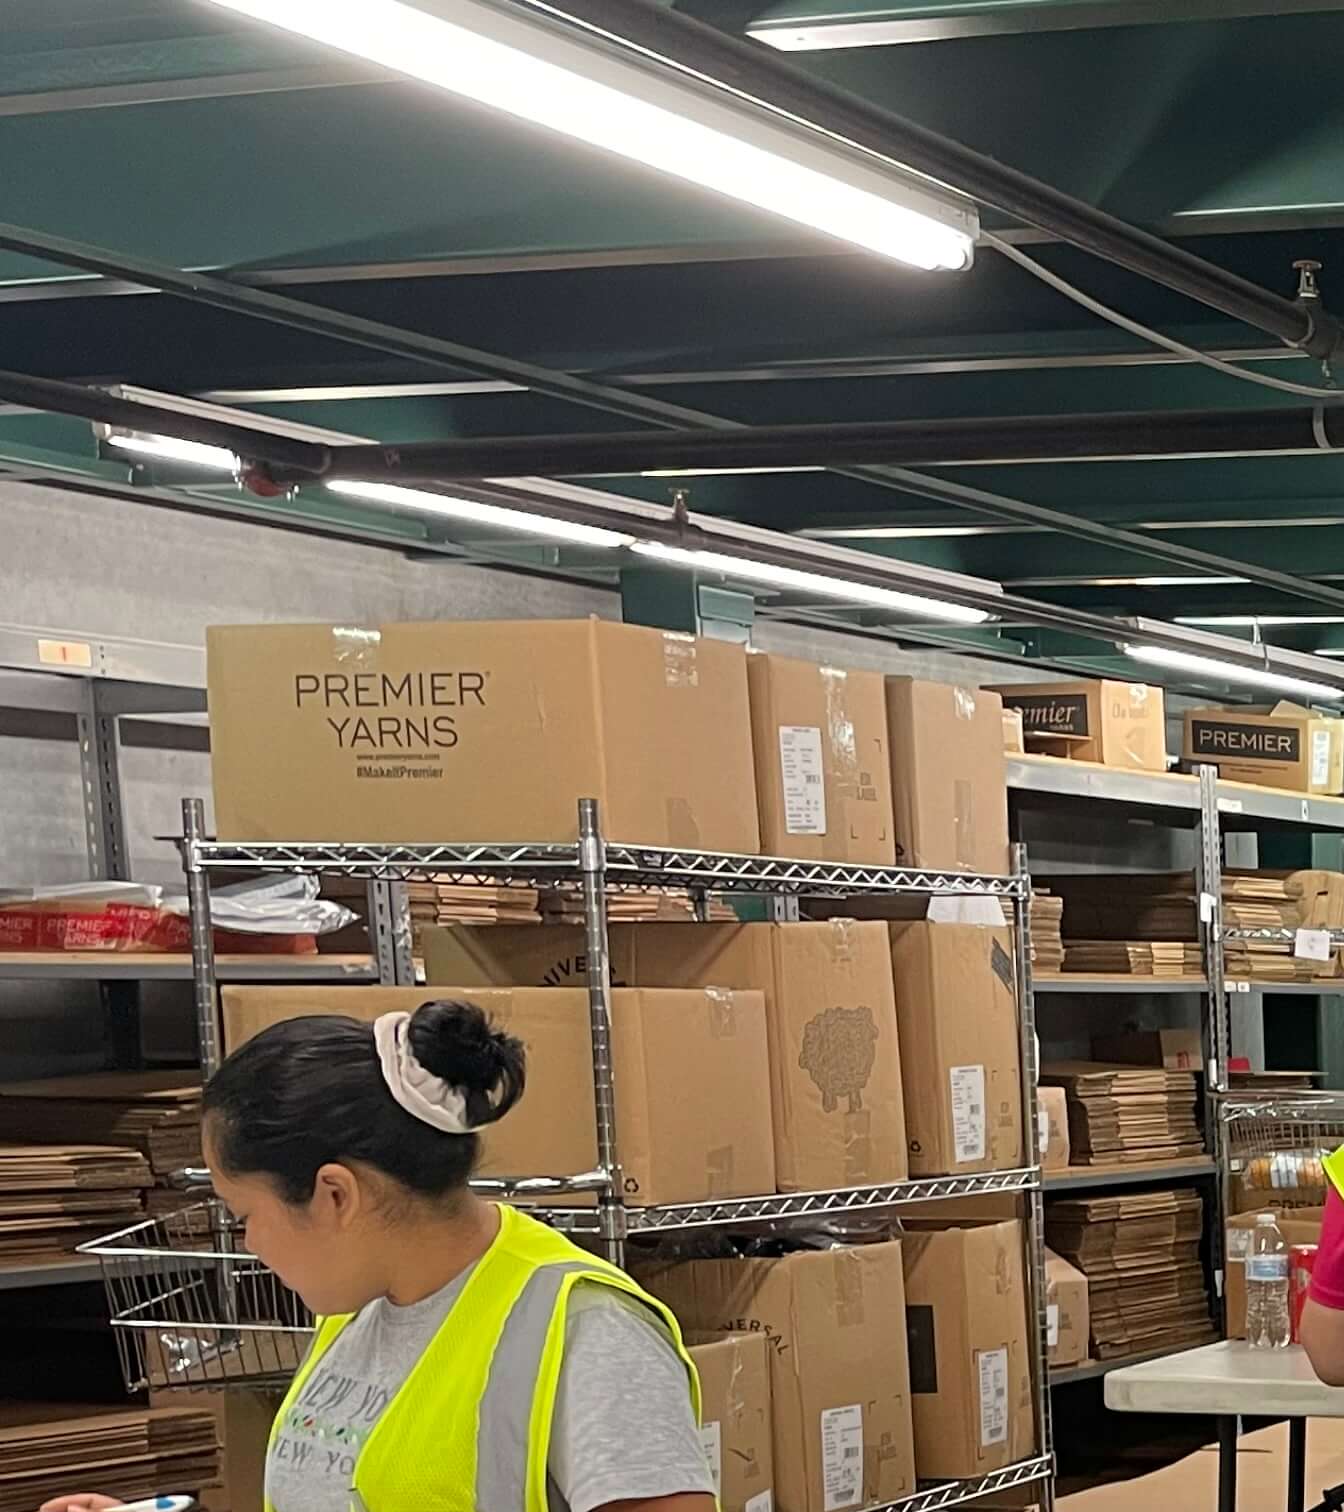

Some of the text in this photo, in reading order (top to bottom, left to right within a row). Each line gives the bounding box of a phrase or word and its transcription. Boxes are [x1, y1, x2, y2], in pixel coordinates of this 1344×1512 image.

[295, 671, 487, 708] PREMIER
[326, 715, 458, 748] YARNS
[1199, 728, 1292, 753] PREMIER
